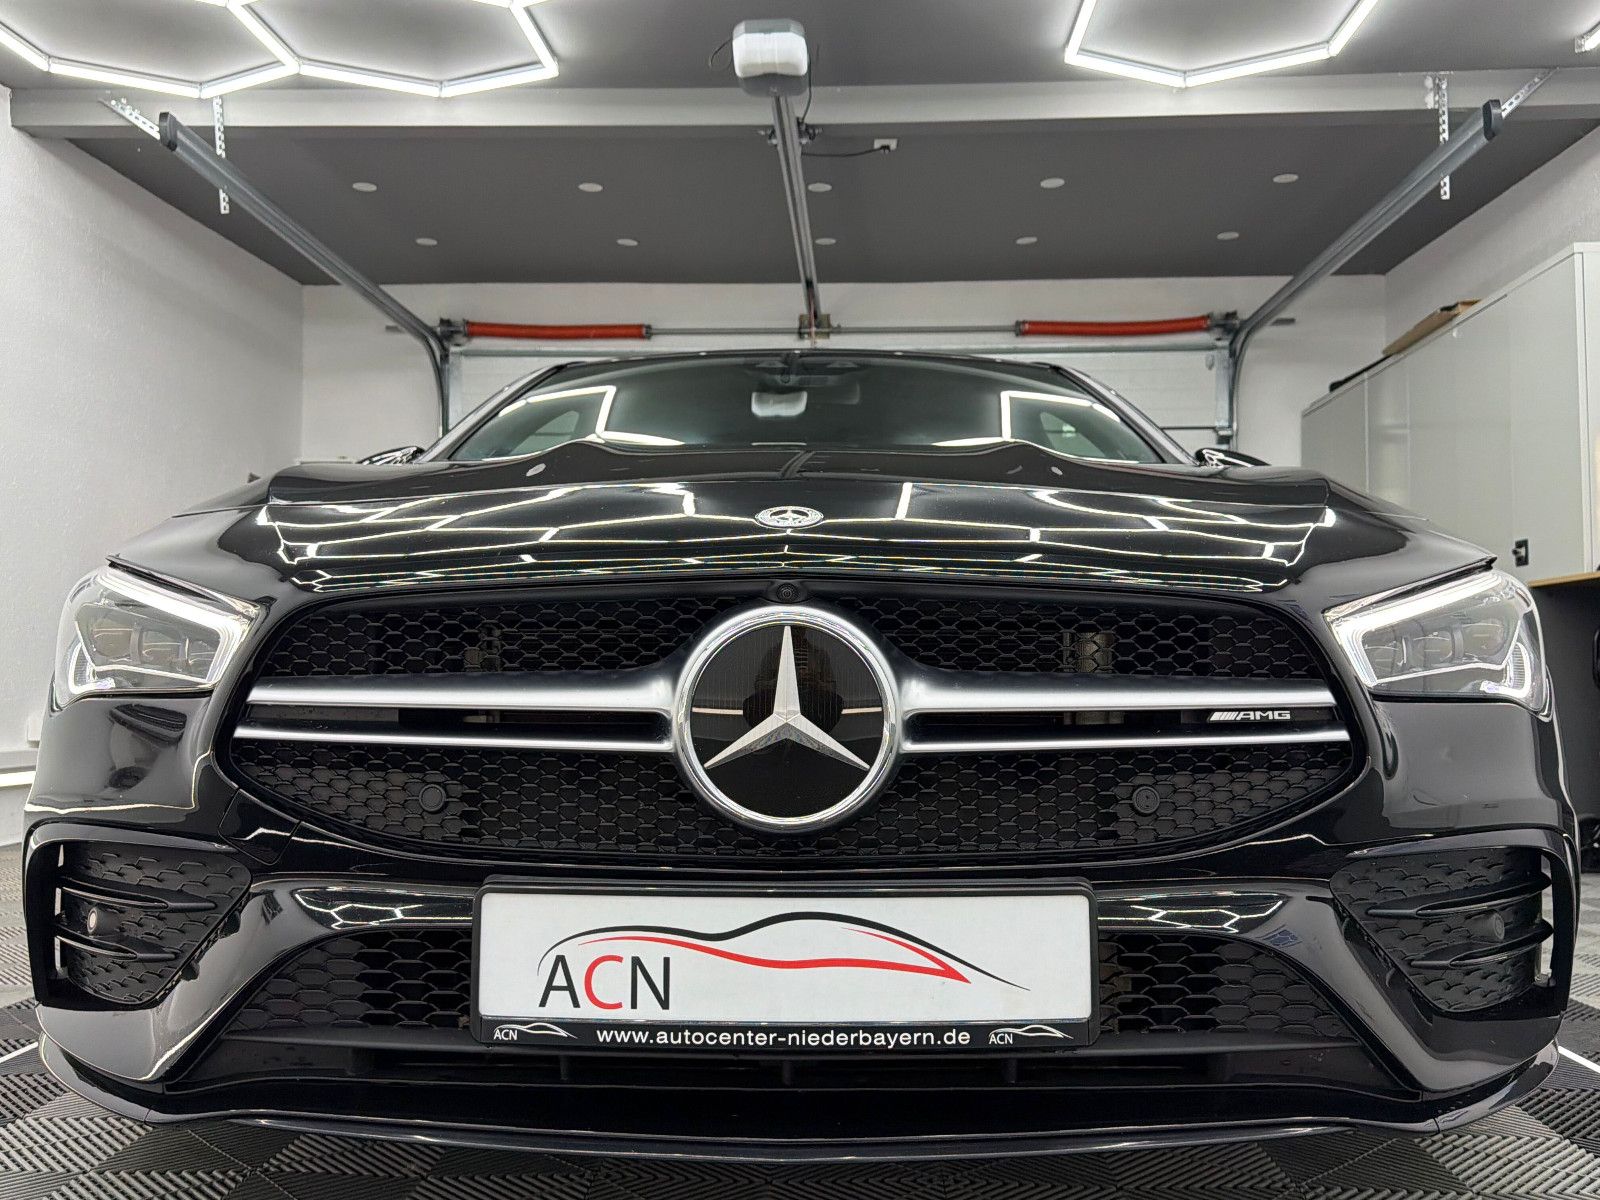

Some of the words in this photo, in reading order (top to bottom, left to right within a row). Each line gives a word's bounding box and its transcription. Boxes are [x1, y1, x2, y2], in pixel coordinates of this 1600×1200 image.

[1235, 710, 1291, 721] AMG
[538, 954, 671, 1011] ACN
[493, 1028, 519, 1042] ACN
[596, 1028, 971, 1049] www.autocenter-niederbayern.de
[988, 1033, 1014, 1046] ACN
